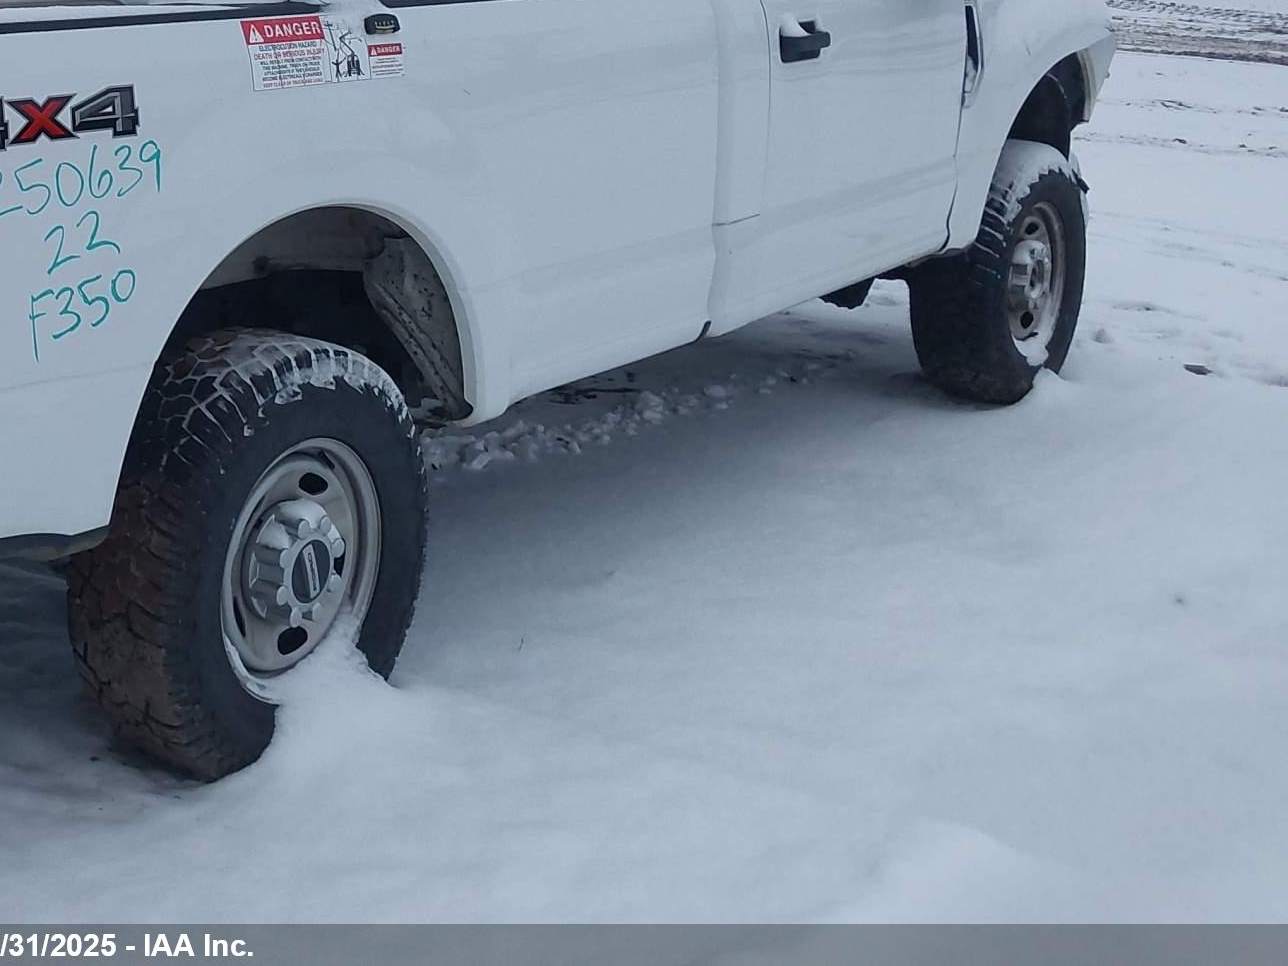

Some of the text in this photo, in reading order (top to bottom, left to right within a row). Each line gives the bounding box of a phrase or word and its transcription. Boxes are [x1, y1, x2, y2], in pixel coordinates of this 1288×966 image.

[263, 21, 322, 38] DANGER
[376, 45, 401, 54] DANGER
[44, 210, 121, 275] 22
[28, 269, 136, 363] F350
